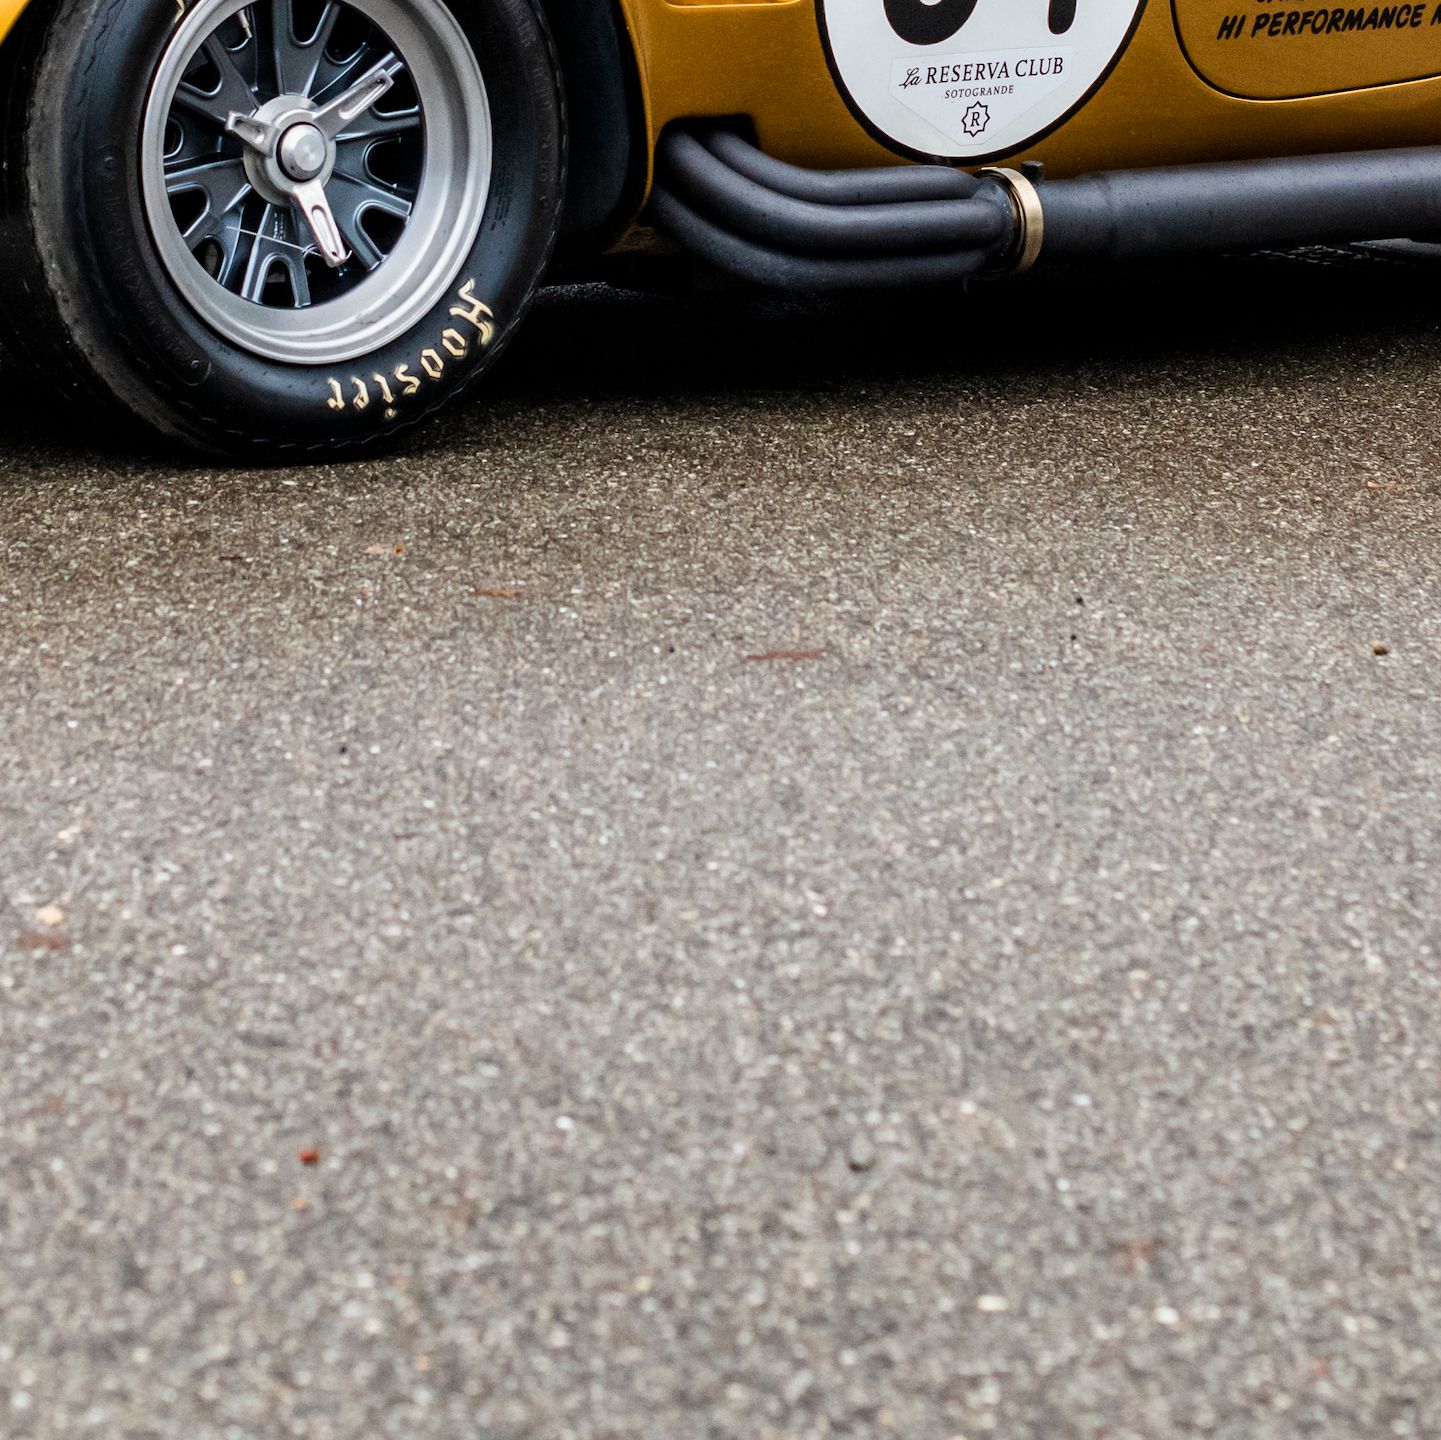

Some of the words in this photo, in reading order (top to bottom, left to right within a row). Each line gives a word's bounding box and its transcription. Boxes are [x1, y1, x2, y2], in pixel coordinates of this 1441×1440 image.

[1216, 14, 1247, 40] HI
[1251, 3, 1424, 38] PERFORMANCE
[898, 67, 923, 90] La
[925, 61, 1010, 85] RESERVA
[1015, 57, 1064, 77] CLUB
[944, 84, 1016, 100] SOTOGRANDE
[970, 111, 981, 127] R
[325, 277, 496, 421] Hoosier
